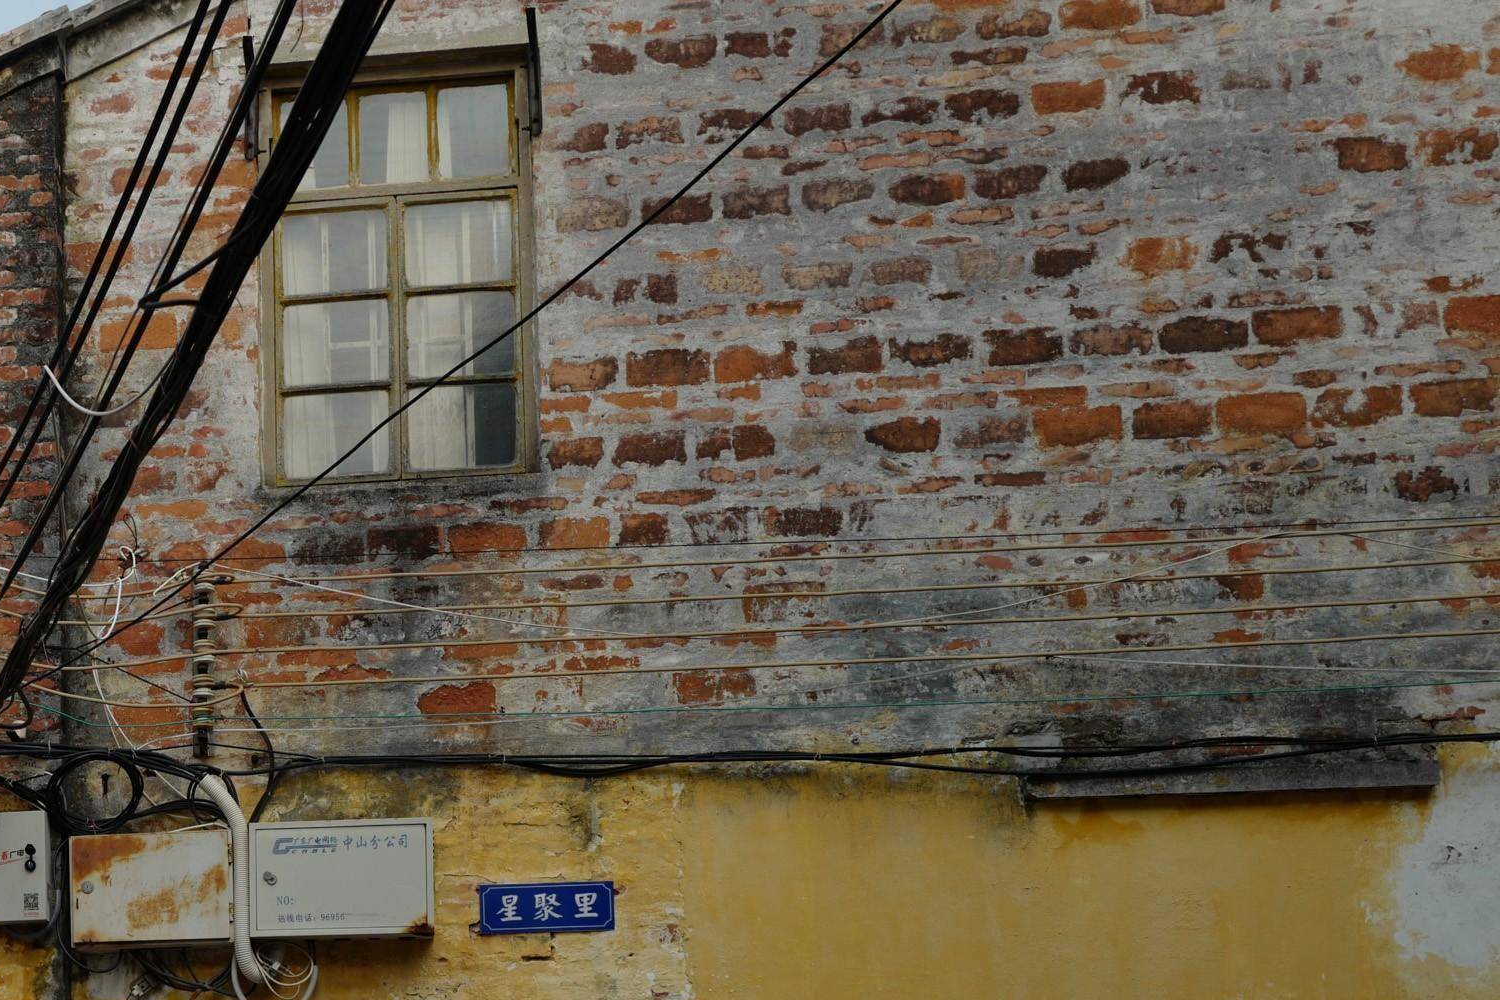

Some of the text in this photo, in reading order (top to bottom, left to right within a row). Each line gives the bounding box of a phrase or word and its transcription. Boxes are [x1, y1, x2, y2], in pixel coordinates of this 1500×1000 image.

[343, 833, 408, 851] 中山分公司
[276, 895, 294, 906] NO:
[496, 892, 599, 922] 星聚里
